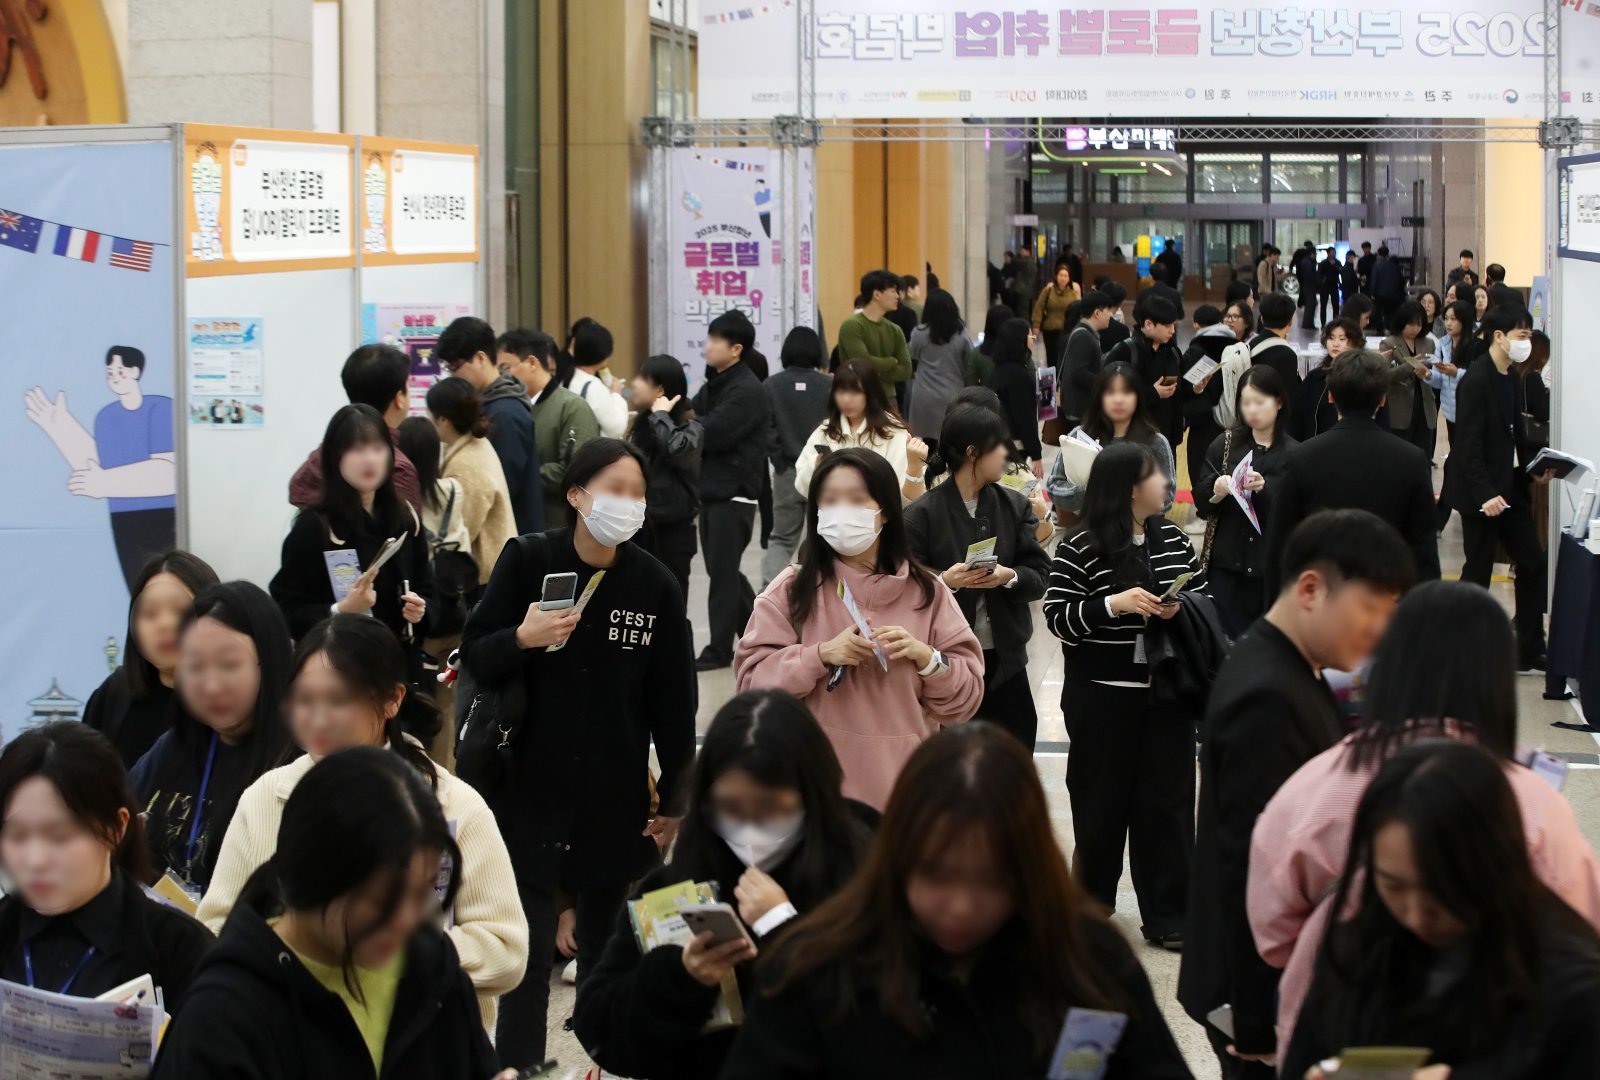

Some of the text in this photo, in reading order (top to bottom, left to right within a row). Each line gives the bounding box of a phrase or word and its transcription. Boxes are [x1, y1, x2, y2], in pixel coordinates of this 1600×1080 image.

[261, 169, 324, 199] 부산청년 글로벌
[308, 208, 341, 236] 프로젝트
[694, 224, 719, 239] 2025
[683, 242, 760, 267] 글로벌
[696, 270, 747, 296] 취업
[609, 609, 657, 629] C'EST
[608, 627, 653, 646] BIEN
